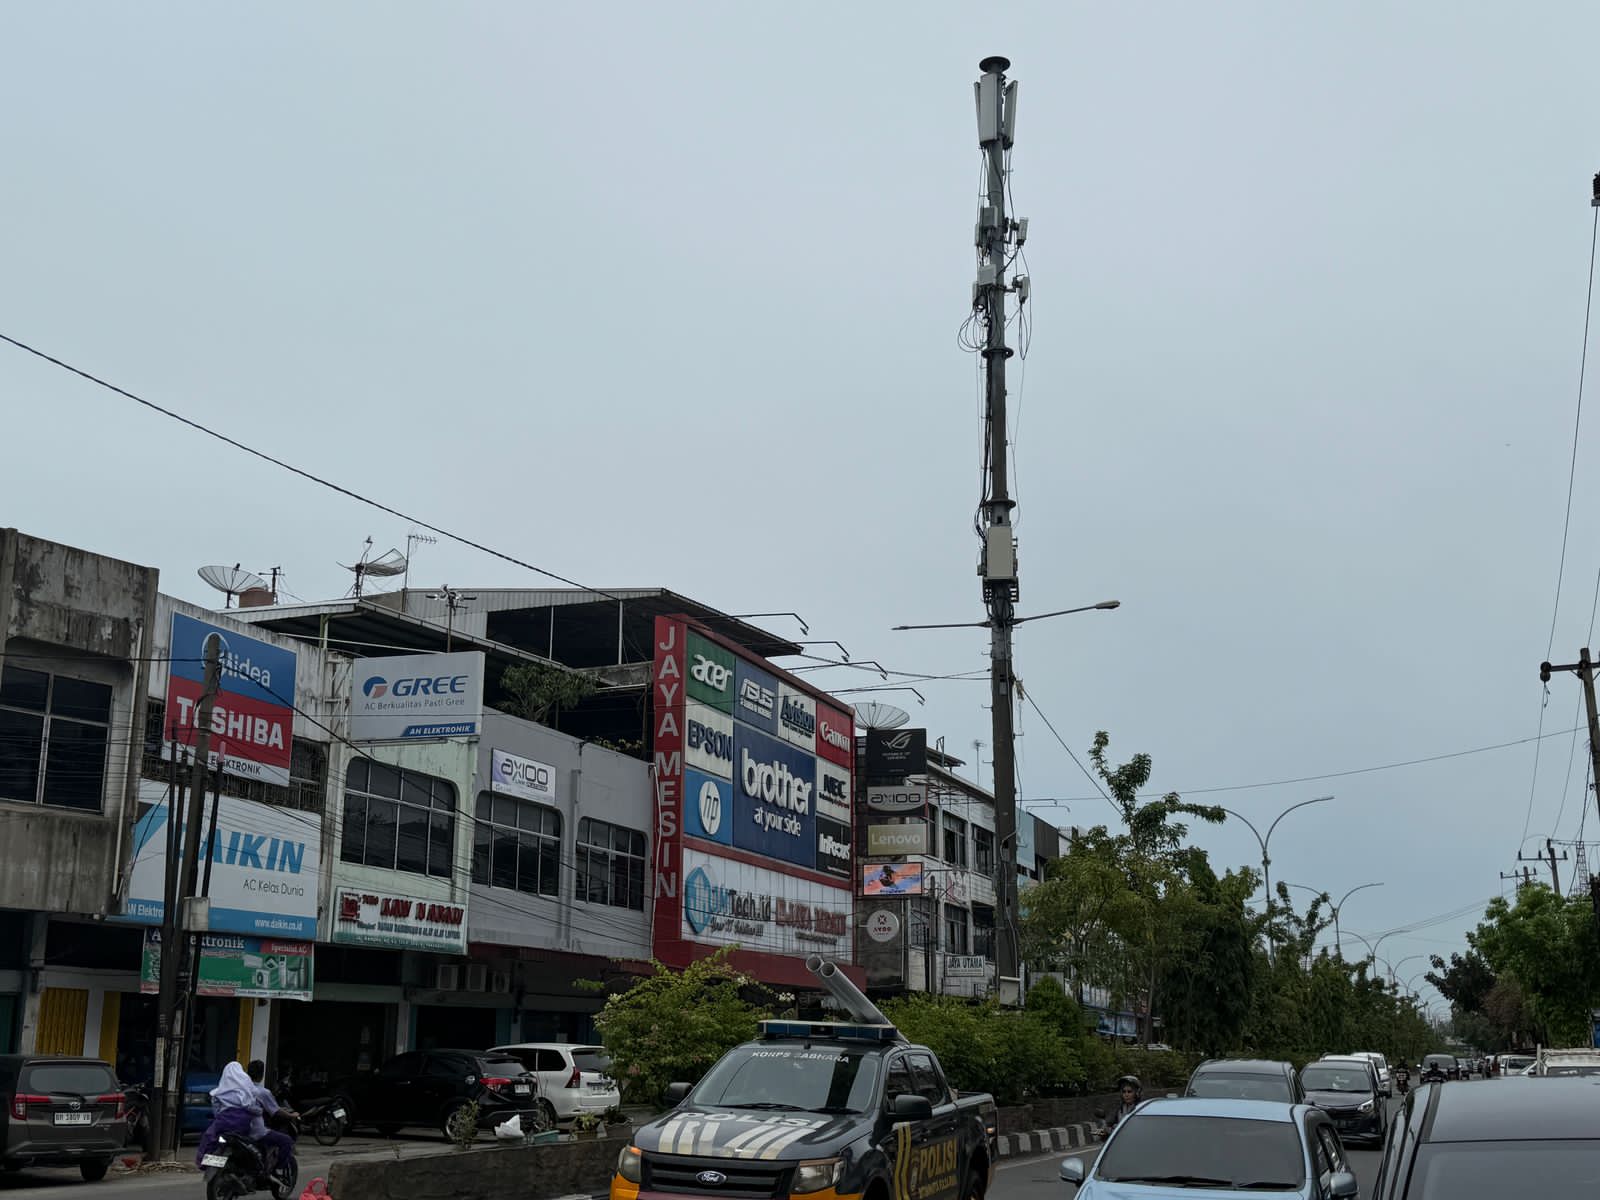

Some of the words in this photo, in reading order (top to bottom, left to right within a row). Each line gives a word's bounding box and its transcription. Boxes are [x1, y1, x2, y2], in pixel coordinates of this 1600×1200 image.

[392, 675, 469, 697] GREE
[658, 626, 681, 737] JAYA
[690, 654, 733, 692] acer
[364, 702, 376, 711] AC
[377, 700, 422, 711] Berkualitas
[424, 699, 444, 708] Pasti
[445, 698, 465, 706] Gree
[780, 695, 815, 734] Avision
[687, 719, 733, 762] EPSON
[820, 720, 850, 753] Canon
[741, 747, 813, 816] brother
[823, 774, 846, 799] NEC
[655, 751, 681, 898] MESIN
[753, 806, 765, 826] at
[764, 811, 783, 832] your
[784, 814, 801, 837] side
[871, 832, 921, 846] Lenovo
[242, 879, 256, 891] AC
[258, 880, 280, 895] Kelas
[280, 883, 304, 897] Dunia
[253, 918, 303, 932] www.daikin.co.id
[673, 1111, 828, 1131] POLISI
[920, 1136, 958, 1180] POLISI
[700, 1171, 720, 1183] Ford
